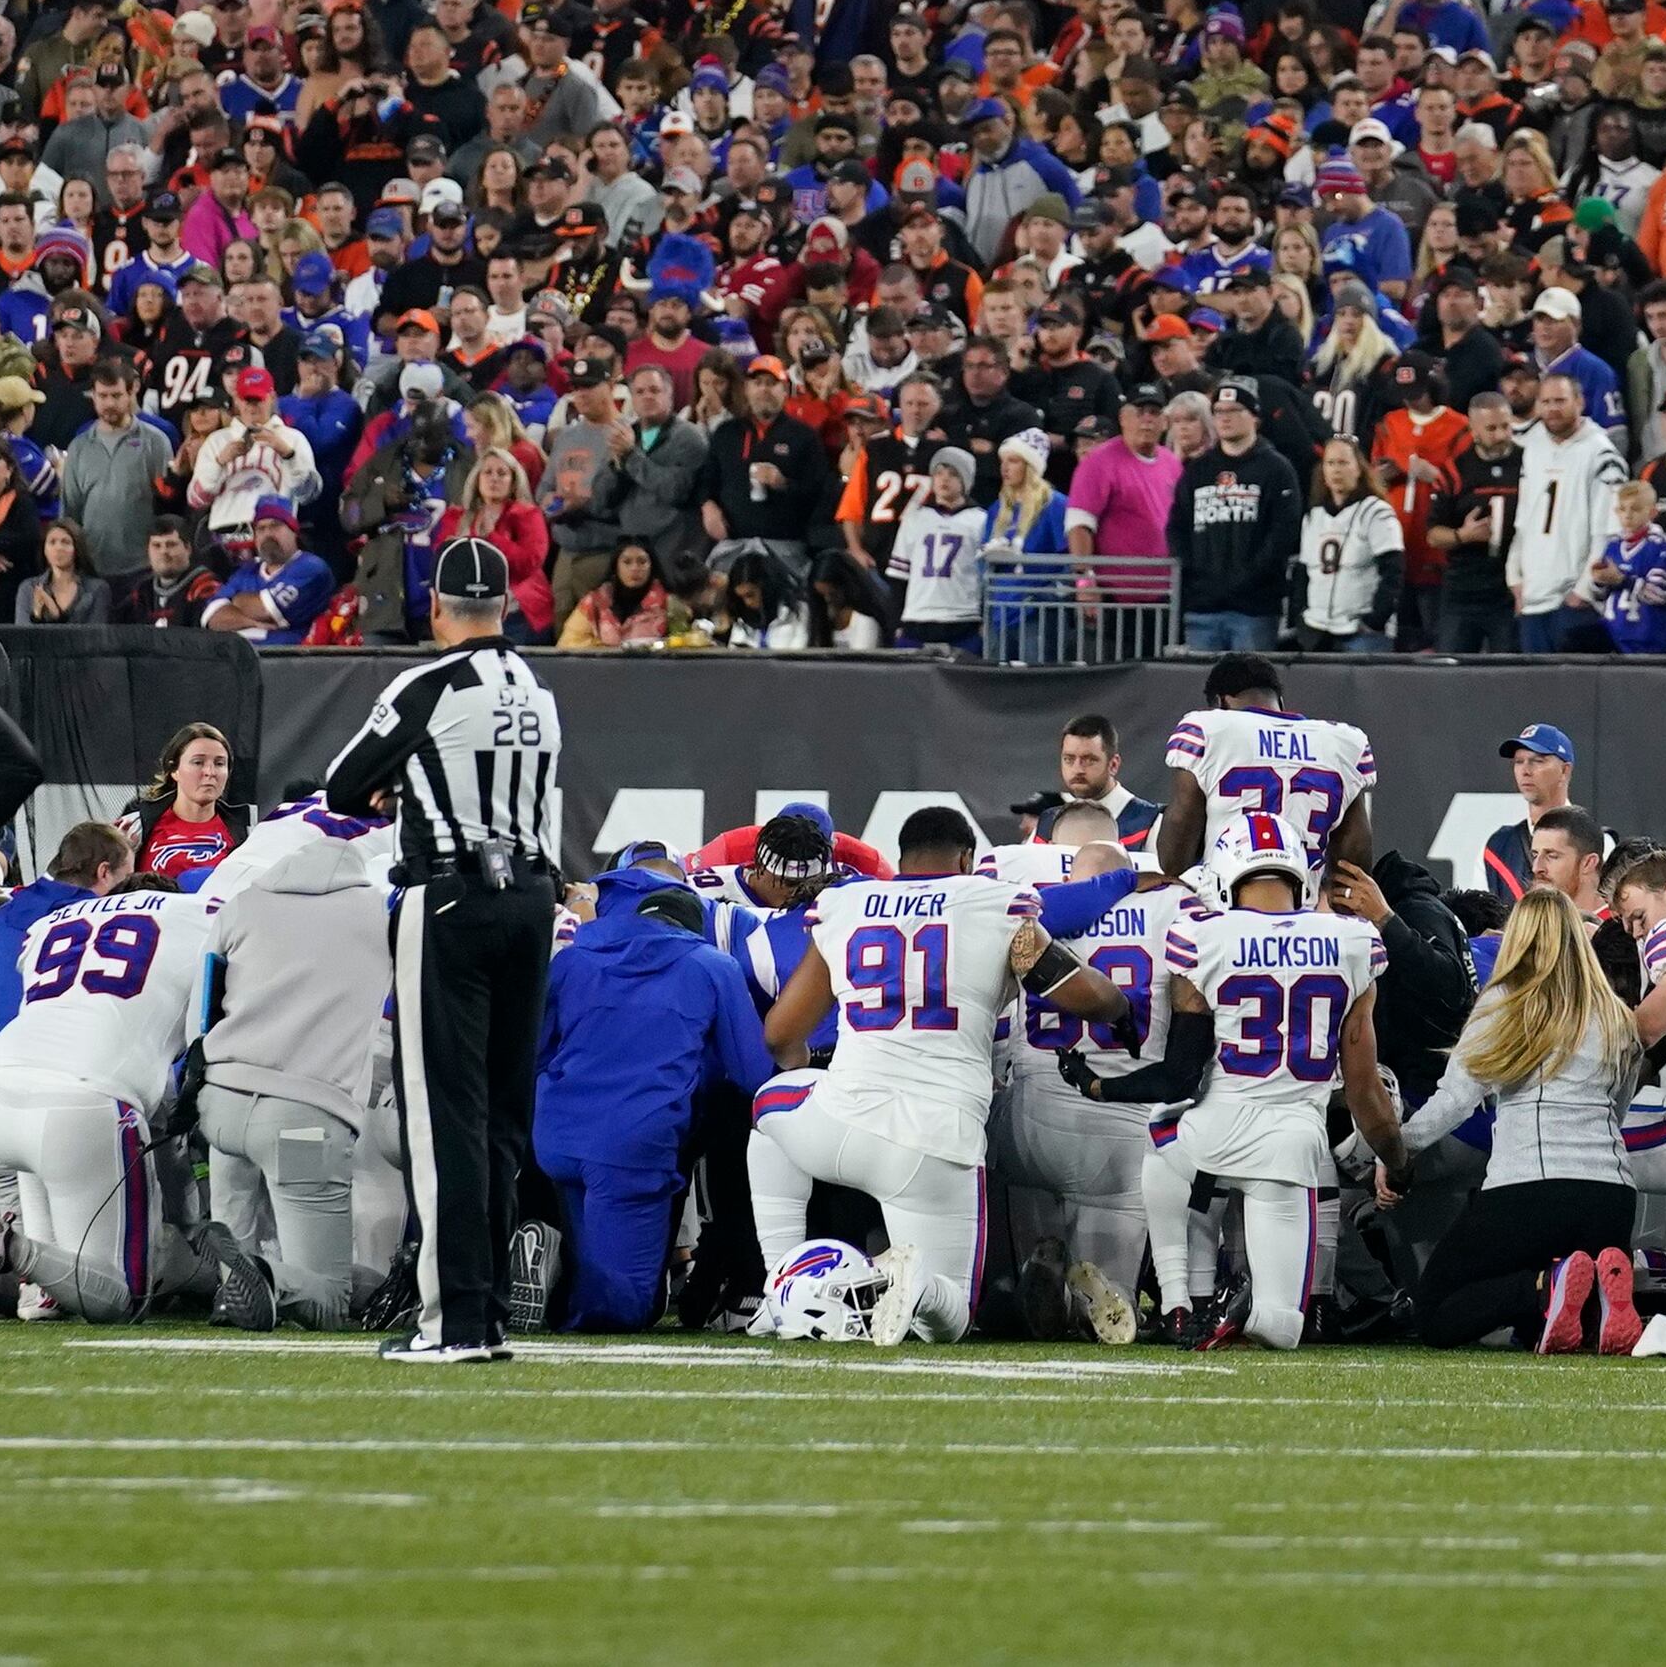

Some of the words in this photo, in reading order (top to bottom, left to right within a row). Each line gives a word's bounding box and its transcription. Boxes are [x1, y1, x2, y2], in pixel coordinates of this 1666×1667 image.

[161, 355, 213, 404] 94
[872, 470, 932, 521] 27
[1542, 480, 1558, 536] 1
[923, 533, 966, 577] 17
[493, 711, 541, 746] 28
[1259, 729, 1318, 763] NEAL
[864, 892, 946, 919] OLIVER
[26, 914, 161, 1002] 99
[1231, 936, 1340, 968] JACKSON
[846, 924, 959, 1032] 91
[1217, 974, 1349, 1082] 30
